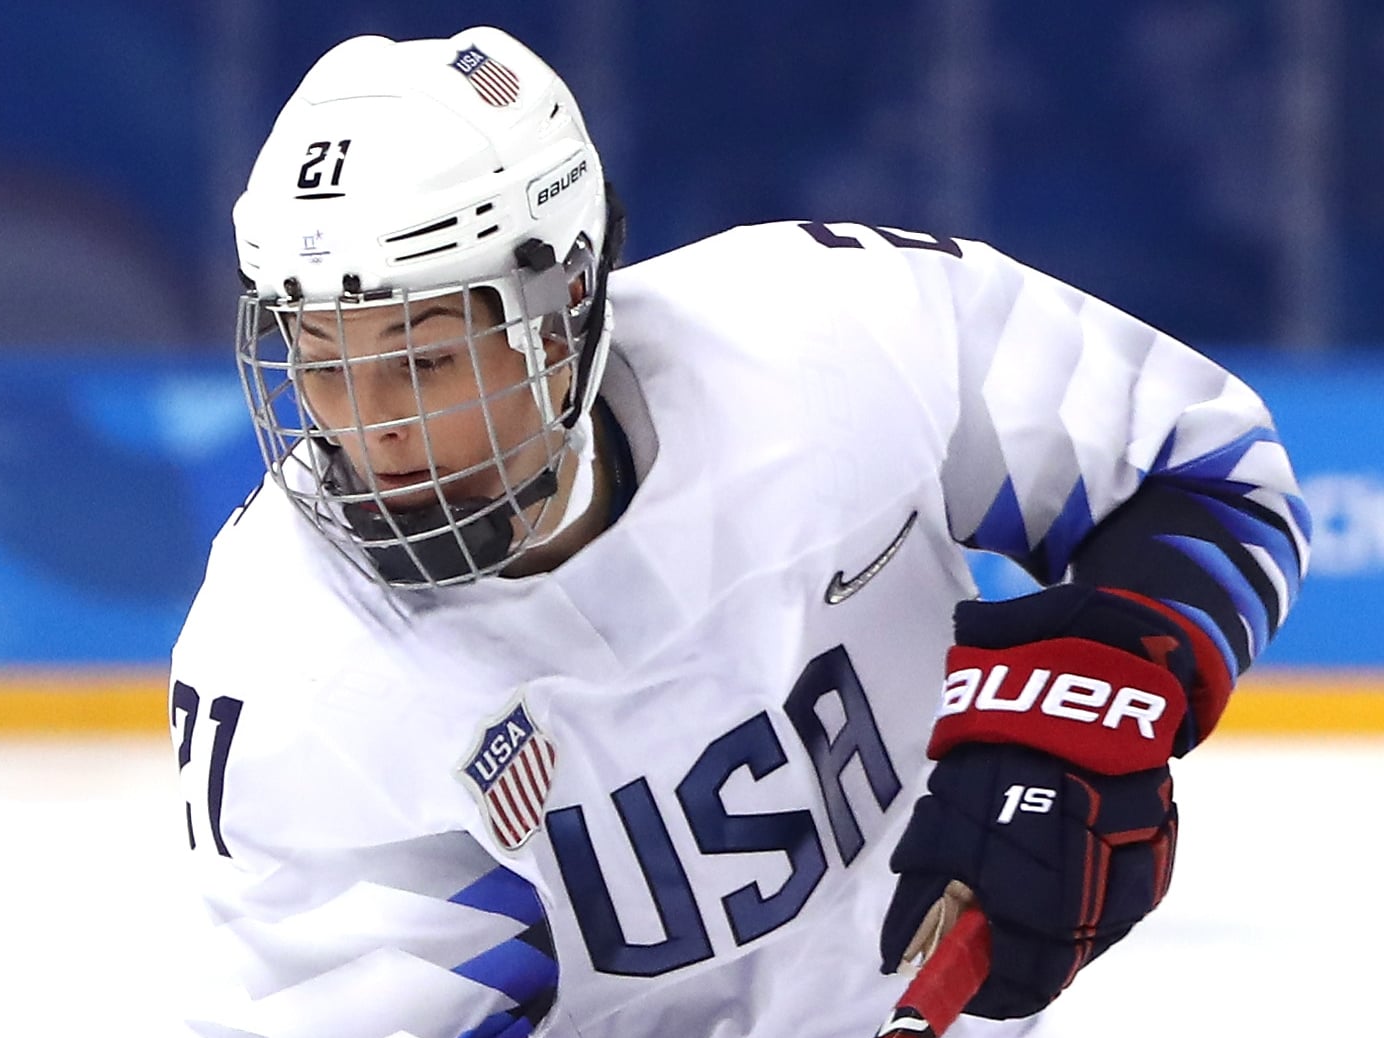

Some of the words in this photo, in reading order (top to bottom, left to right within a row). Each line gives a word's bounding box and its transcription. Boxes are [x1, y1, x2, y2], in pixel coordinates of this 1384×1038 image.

[455, 51, 484, 73] USA
[297, 139, 351, 189] 21
[537, 160, 588, 206] BAUER
[937, 664, 1167, 739] AUER
[475, 721, 526, 781] USA
[547, 644, 903, 977] USA
[996, 784, 1057, 825] 1S
